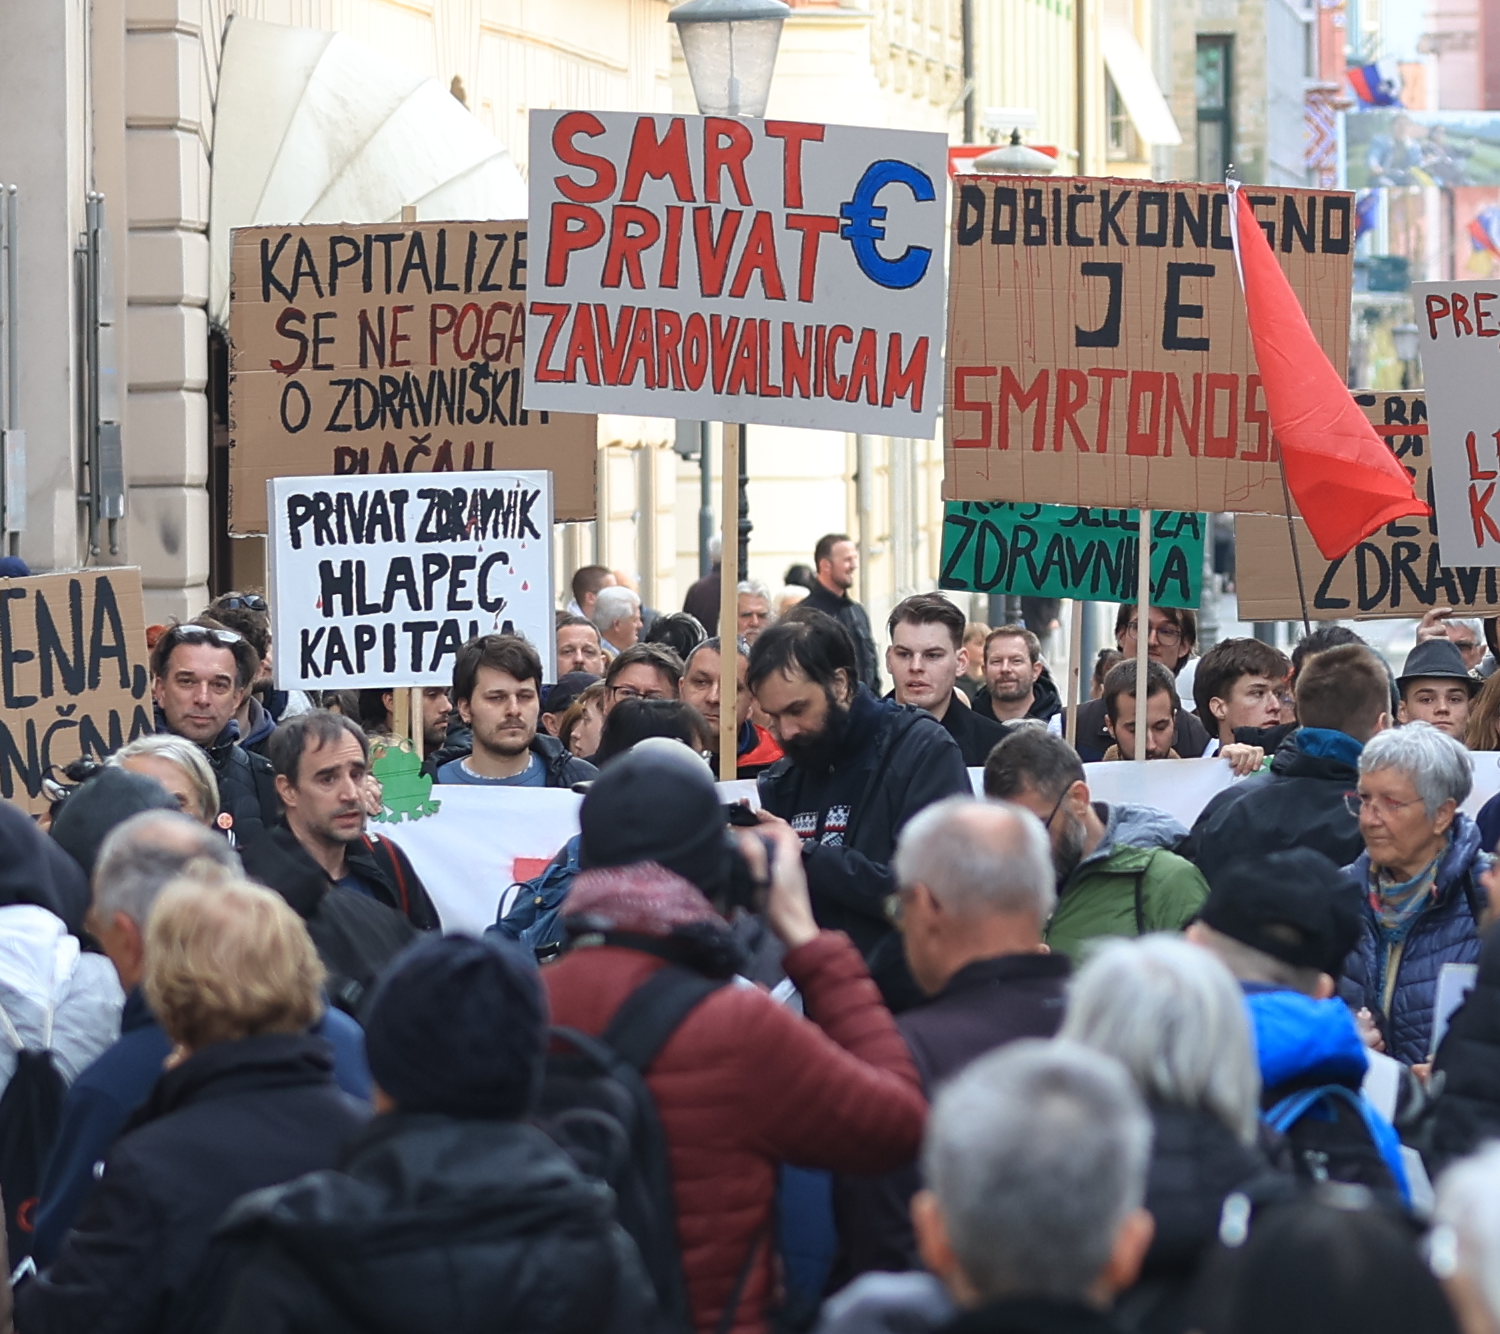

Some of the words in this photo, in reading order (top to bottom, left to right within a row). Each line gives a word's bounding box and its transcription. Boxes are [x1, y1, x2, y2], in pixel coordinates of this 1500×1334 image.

[552, 111, 825, 209] SMRT
[269, 305, 338, 378] SE
[358, 304, 414, 369] NE
[1075, 261, 1215, 351] JE
[280, 380, 311, 434] O
[324, 360, 549, 433] ZDRAVNIŠKI
[529, 303, 929, 413] ZAVAROVALNICAM
[953, 366, 1279, 462] SMRTONOS
[287, 489, 409, 549] PRIVAT
[318, 551, 509, 617] HLAPEC
